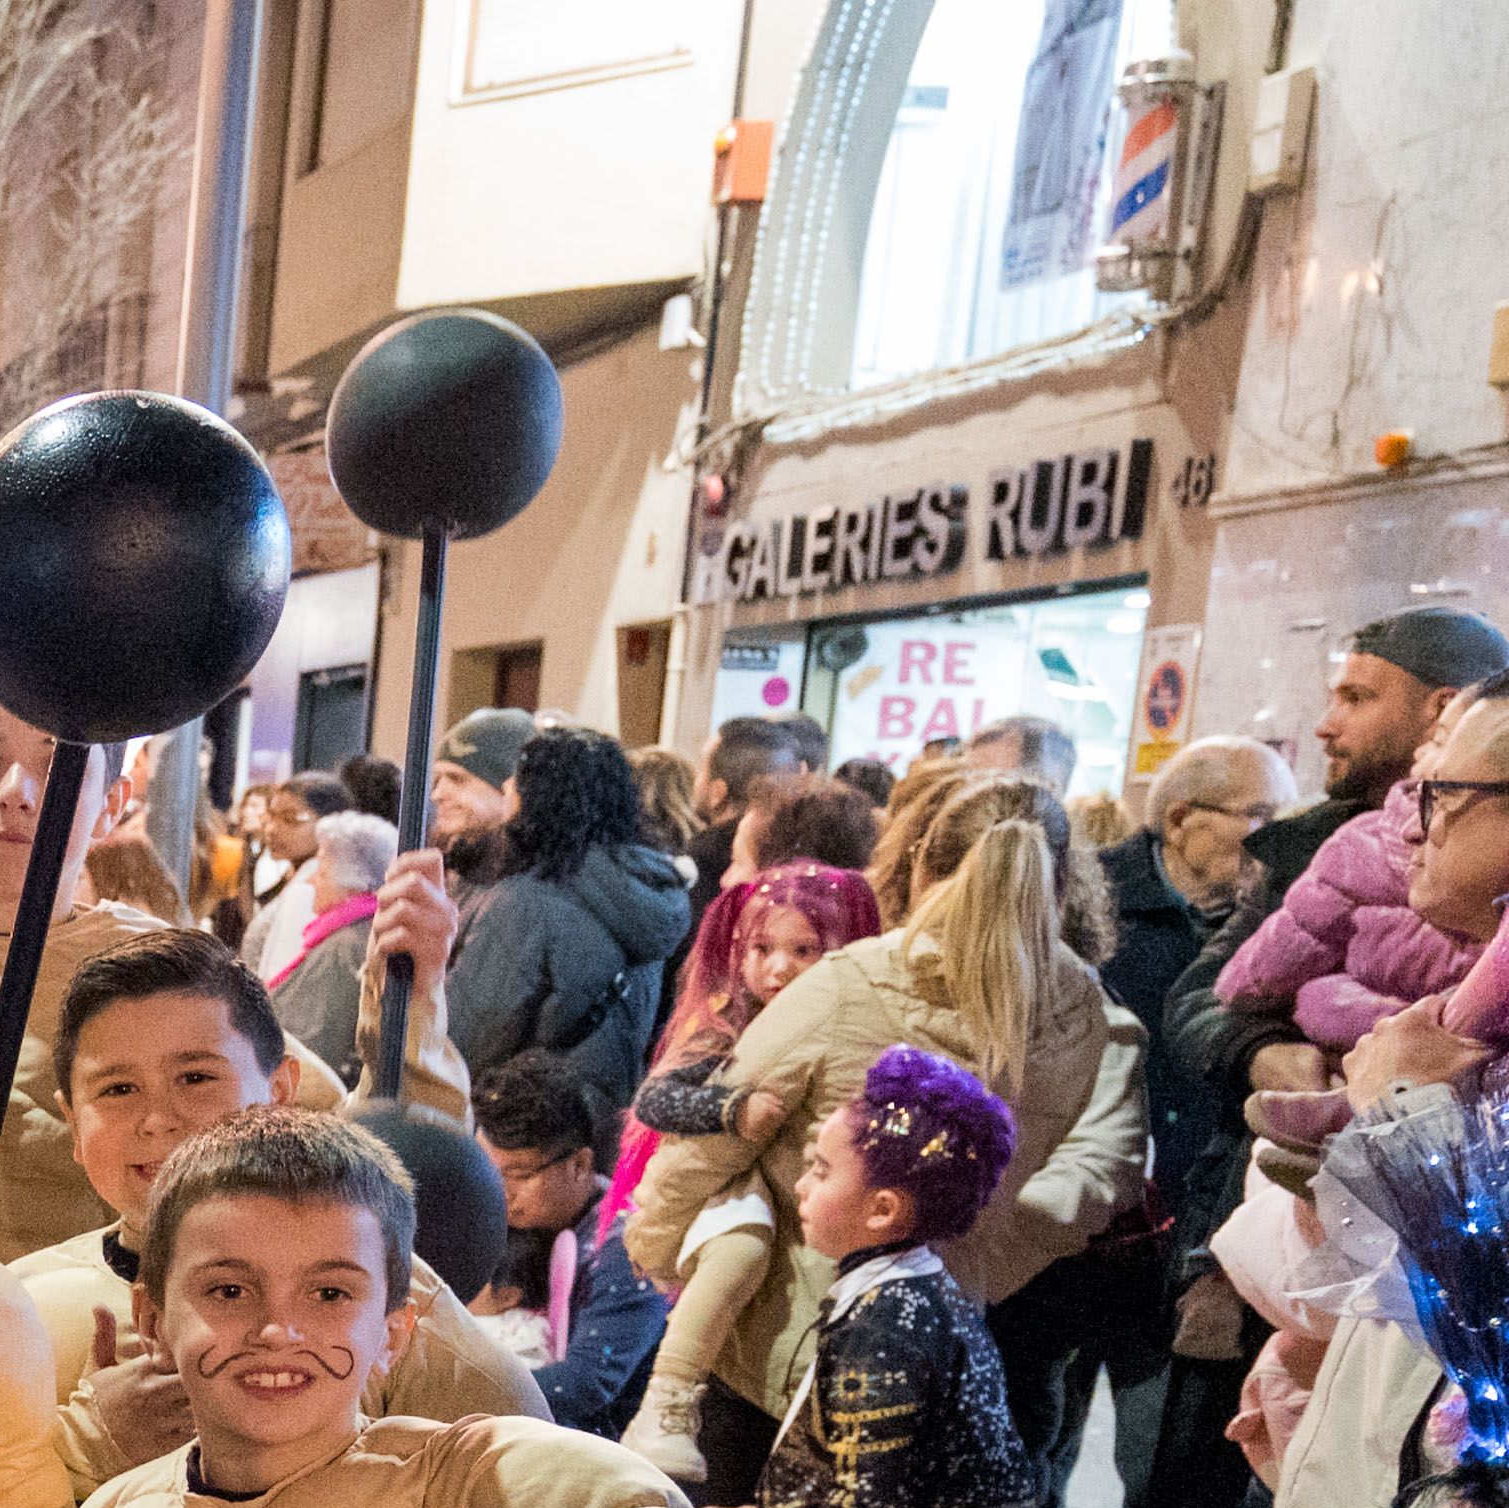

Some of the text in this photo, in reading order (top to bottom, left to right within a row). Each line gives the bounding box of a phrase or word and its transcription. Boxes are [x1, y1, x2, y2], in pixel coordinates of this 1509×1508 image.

[722, 440, 1148, 599] GALERIES RUBI
[898, 639, 977, 686] RE
